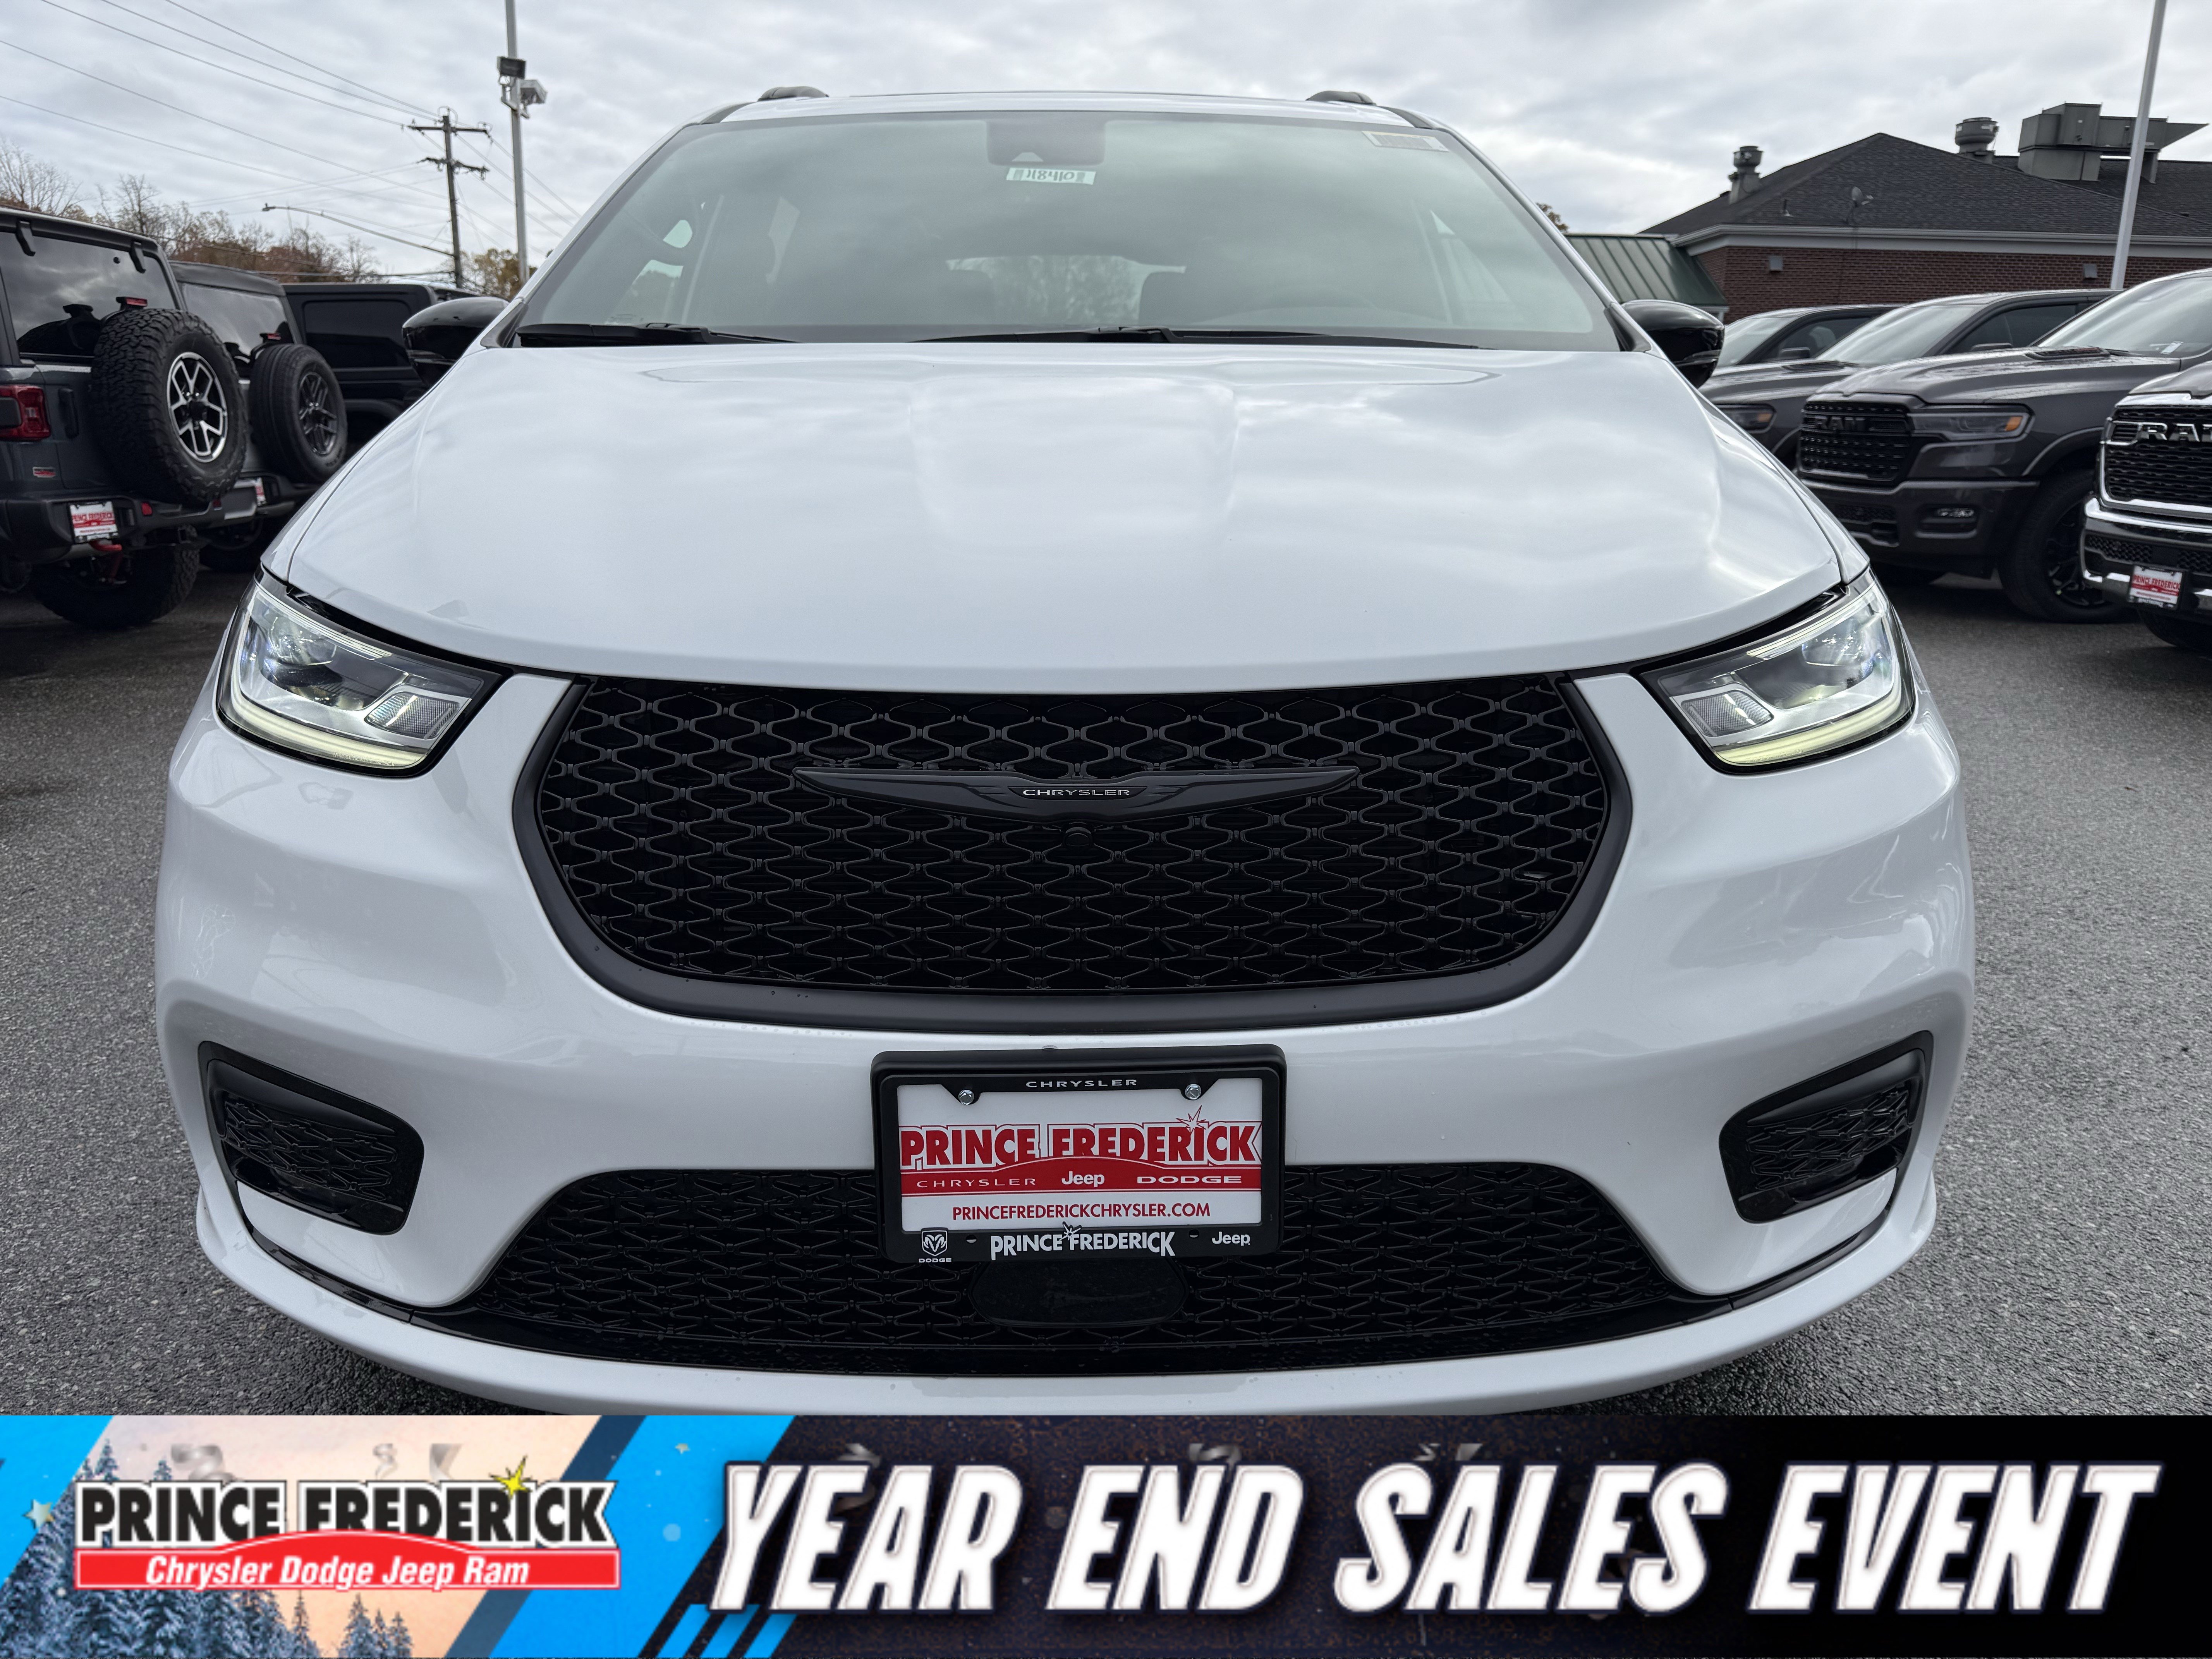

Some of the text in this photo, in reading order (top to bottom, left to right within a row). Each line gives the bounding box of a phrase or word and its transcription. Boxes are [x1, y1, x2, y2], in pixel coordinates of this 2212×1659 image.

[1026, 1079, 1137, 1088] CHRYSLER
[901, 1126, 1255, 1166] PRINCE FREDERICK
[916, 1171, 1242, 1188] CHRYSLER Jeep DODGE
[953, 1203, 1211, 1220] PRINCEFREDERICKCHRYSLER.COM
[991, 1231, 1175, 1261] PRINCE FREDERICK
[1212, 1231, 1250, 1247] Jeep
